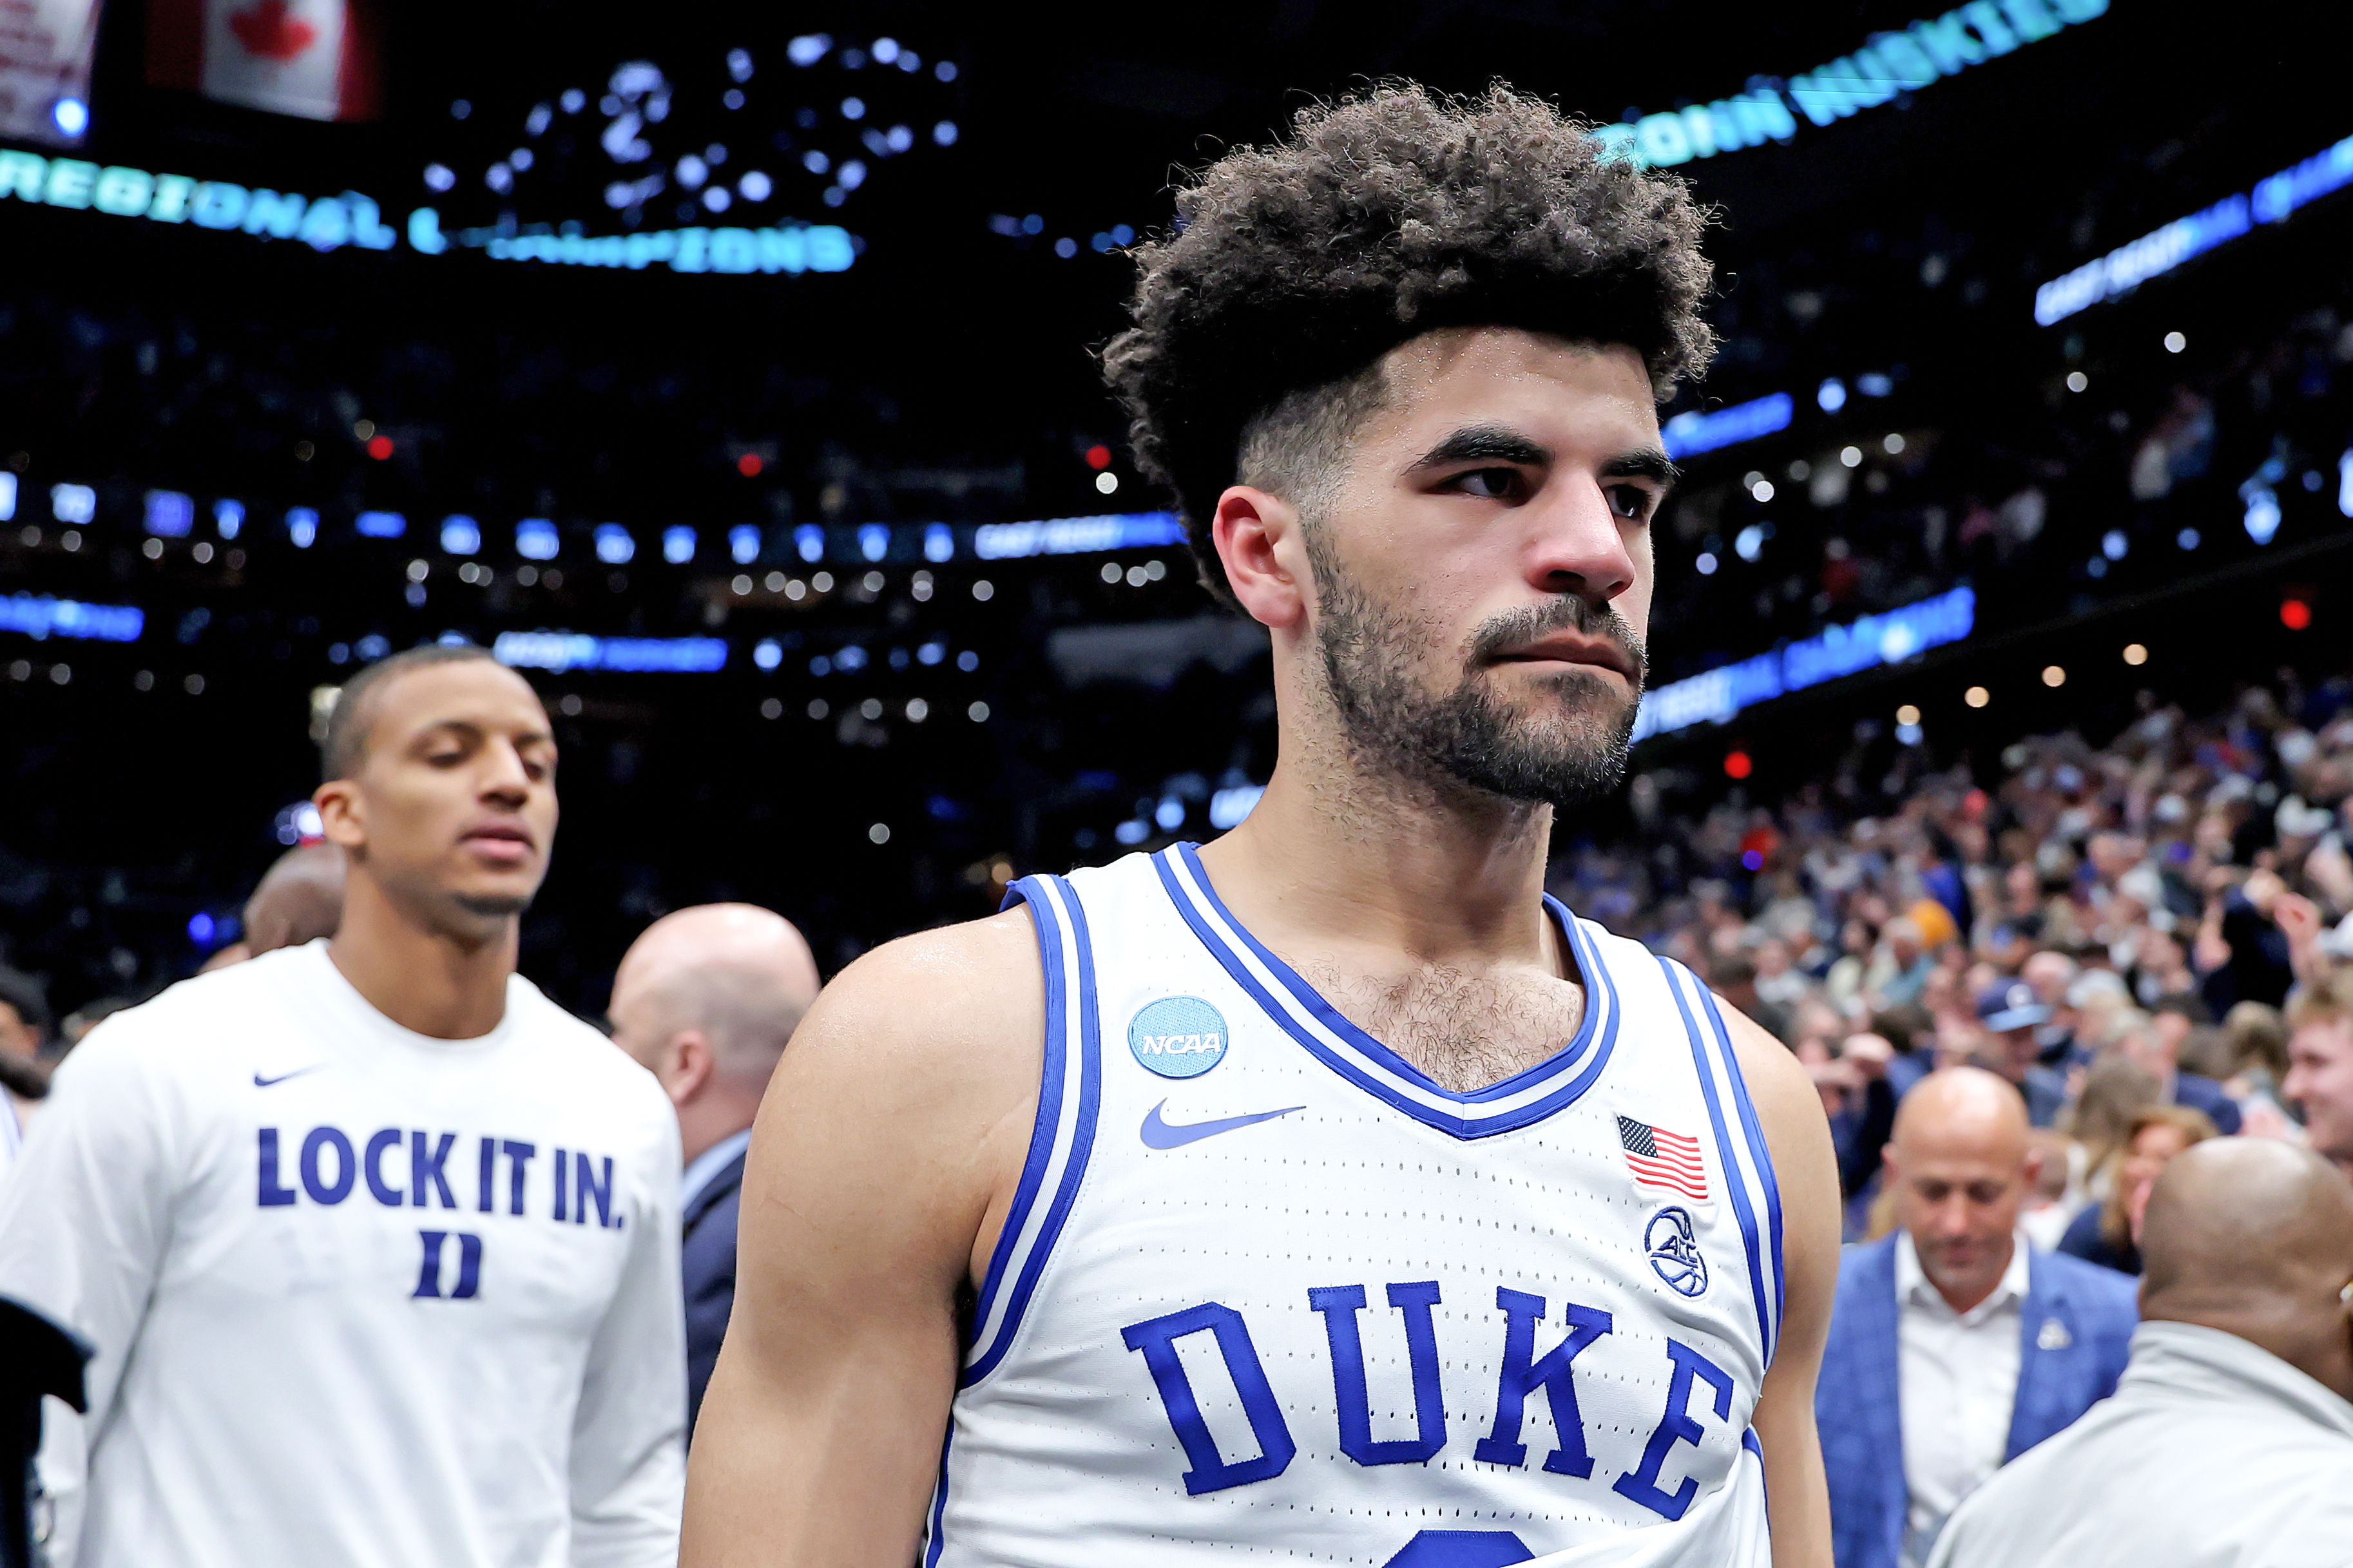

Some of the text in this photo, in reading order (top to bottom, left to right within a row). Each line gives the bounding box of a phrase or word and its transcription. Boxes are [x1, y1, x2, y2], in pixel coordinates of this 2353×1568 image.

[1142, 1033, 1222, 1055] NCAA
[257, 1127, 624, 1229] LOCK IT IN.
[1120, 1280, 1734, 1522] DUKE
